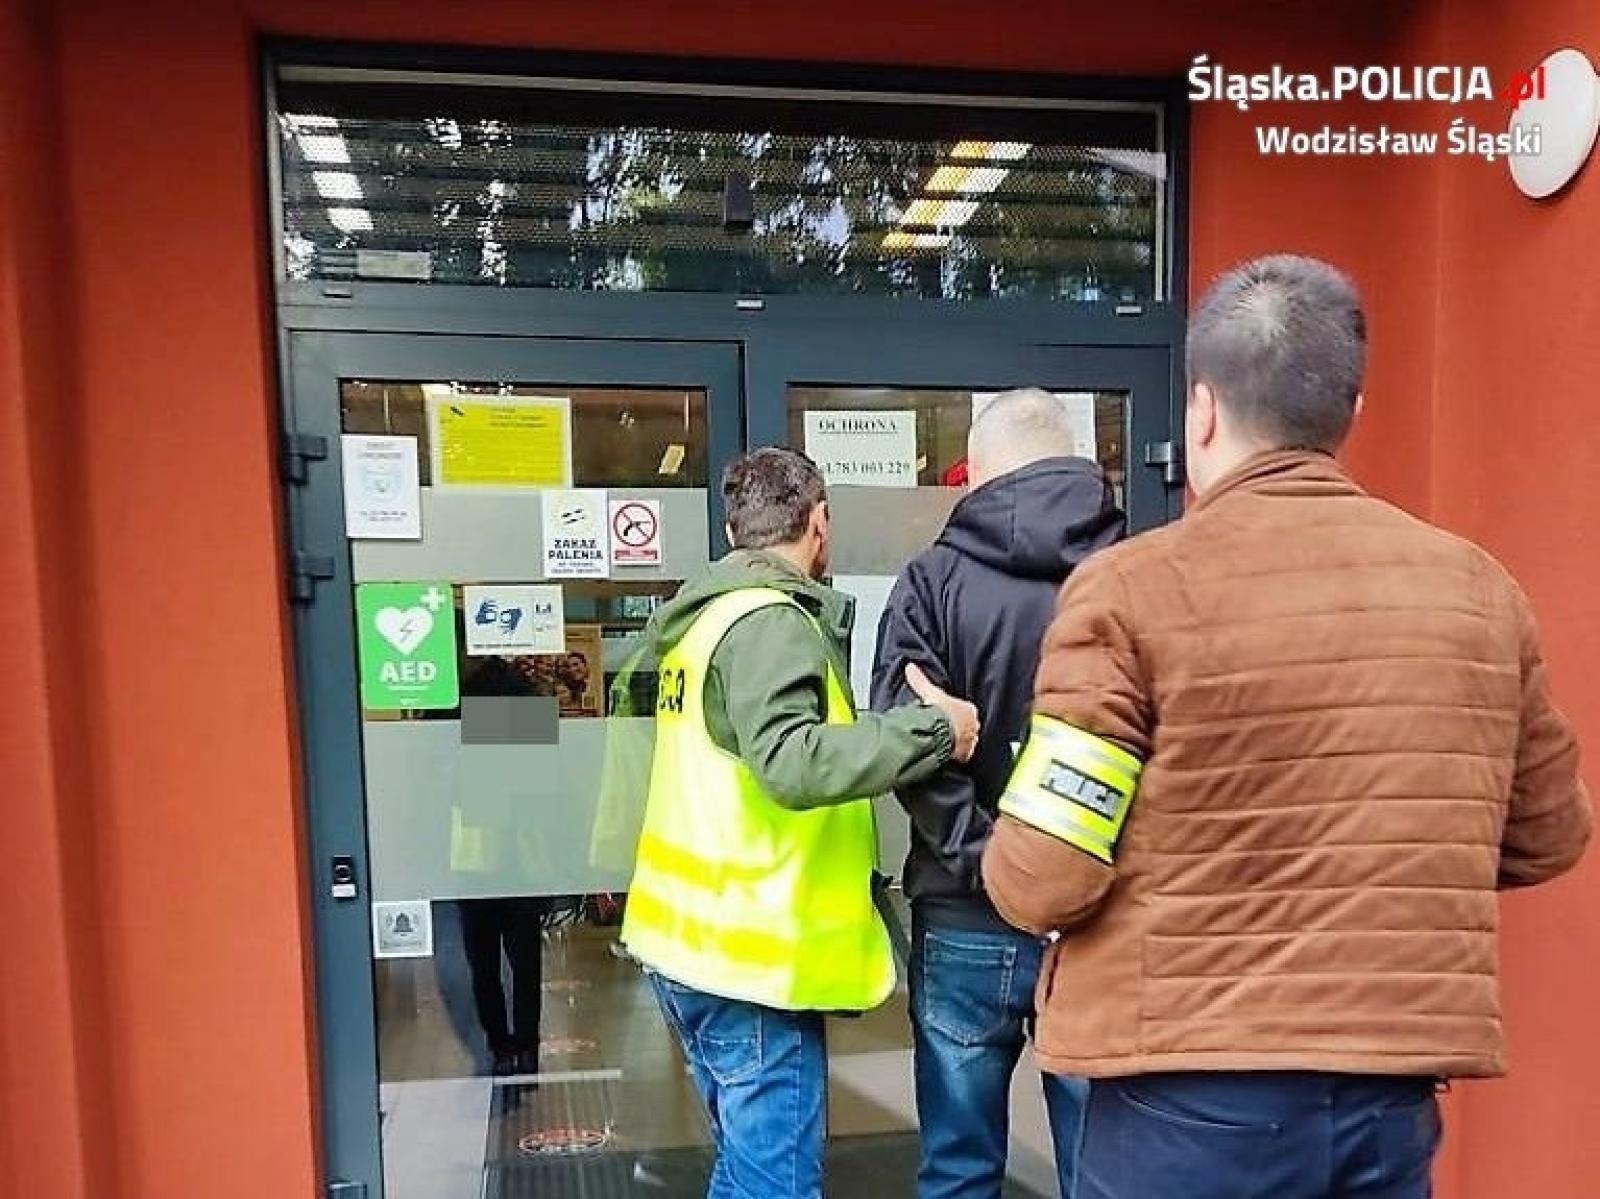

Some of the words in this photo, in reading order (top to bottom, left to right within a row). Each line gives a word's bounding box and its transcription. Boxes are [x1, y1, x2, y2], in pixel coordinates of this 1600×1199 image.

[819, 418, 897, 431] OCHRONA
[554, 539, 597, 549] ZAKAZ
[548, 550, 604, 560] PALENIA
[379, 660, 437, 683] AED
